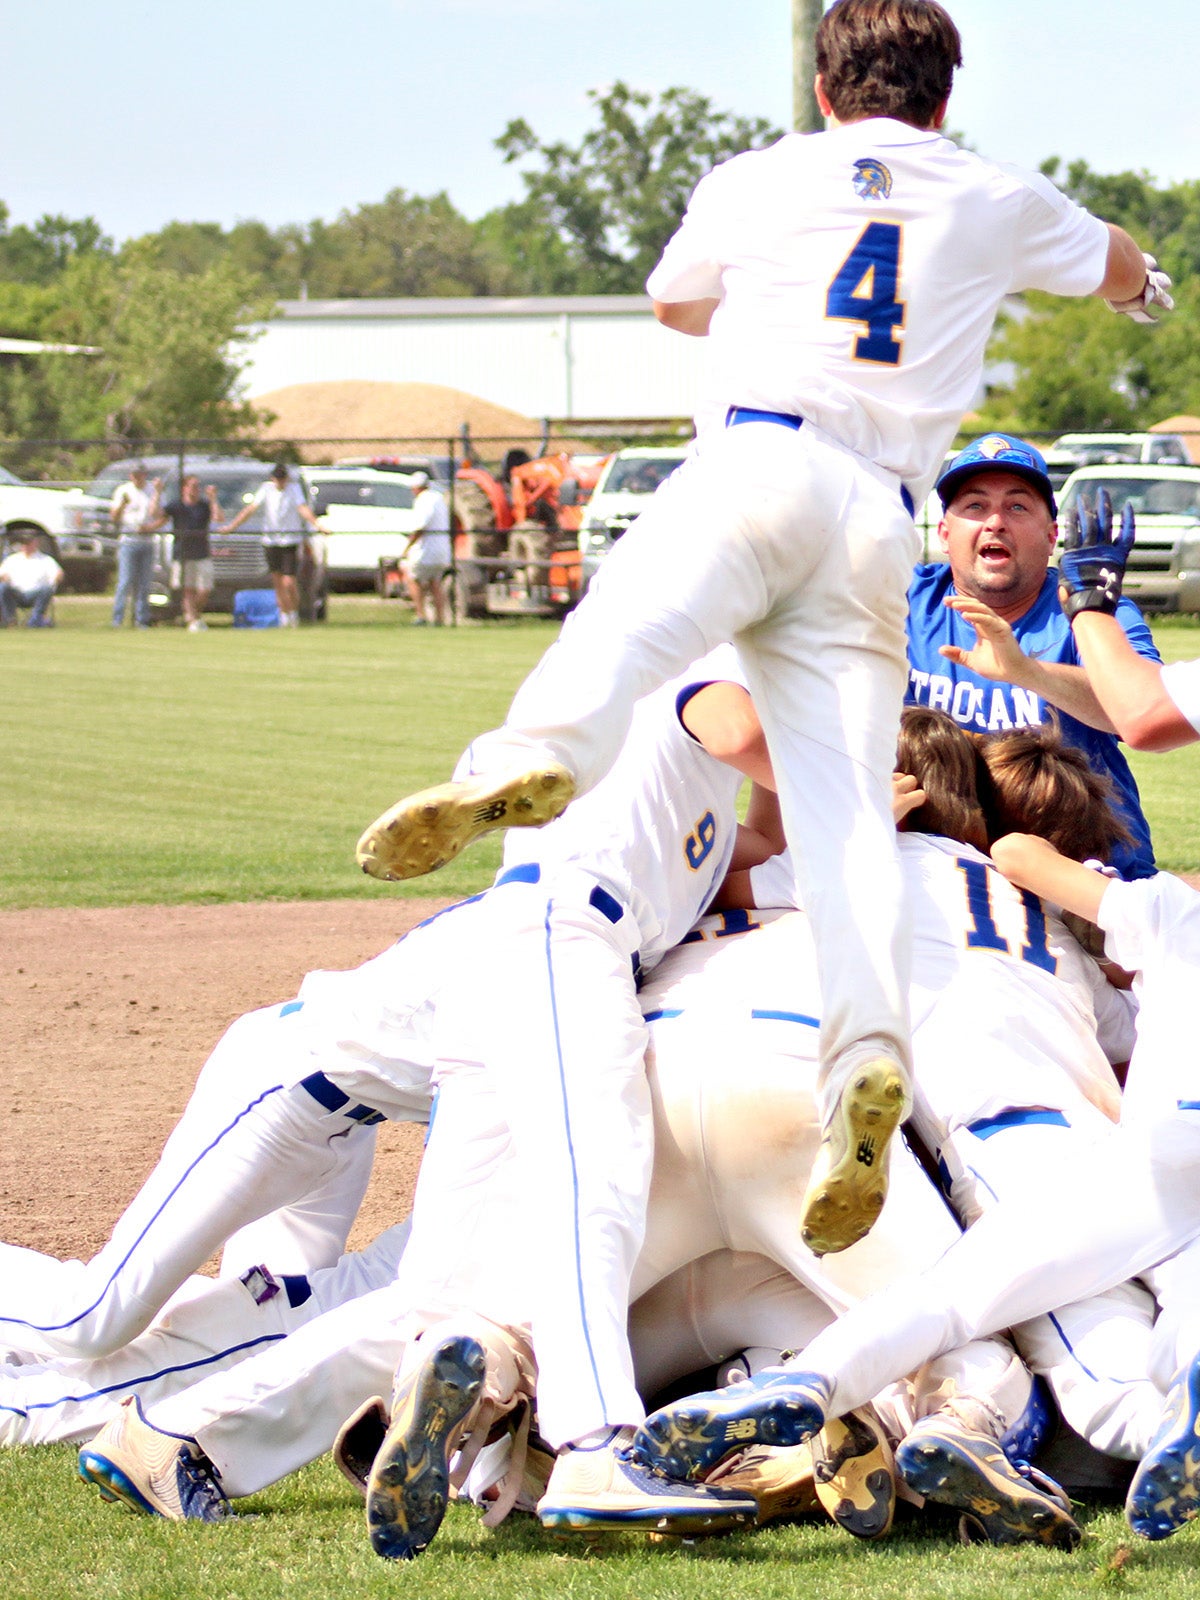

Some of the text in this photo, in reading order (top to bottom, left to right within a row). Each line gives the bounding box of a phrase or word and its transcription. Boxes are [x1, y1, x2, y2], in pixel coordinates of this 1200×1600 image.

[823, 217, 907, 368] 4
[683, 808, 716, 873] 9
[954, 855, 1059, 976] 11
